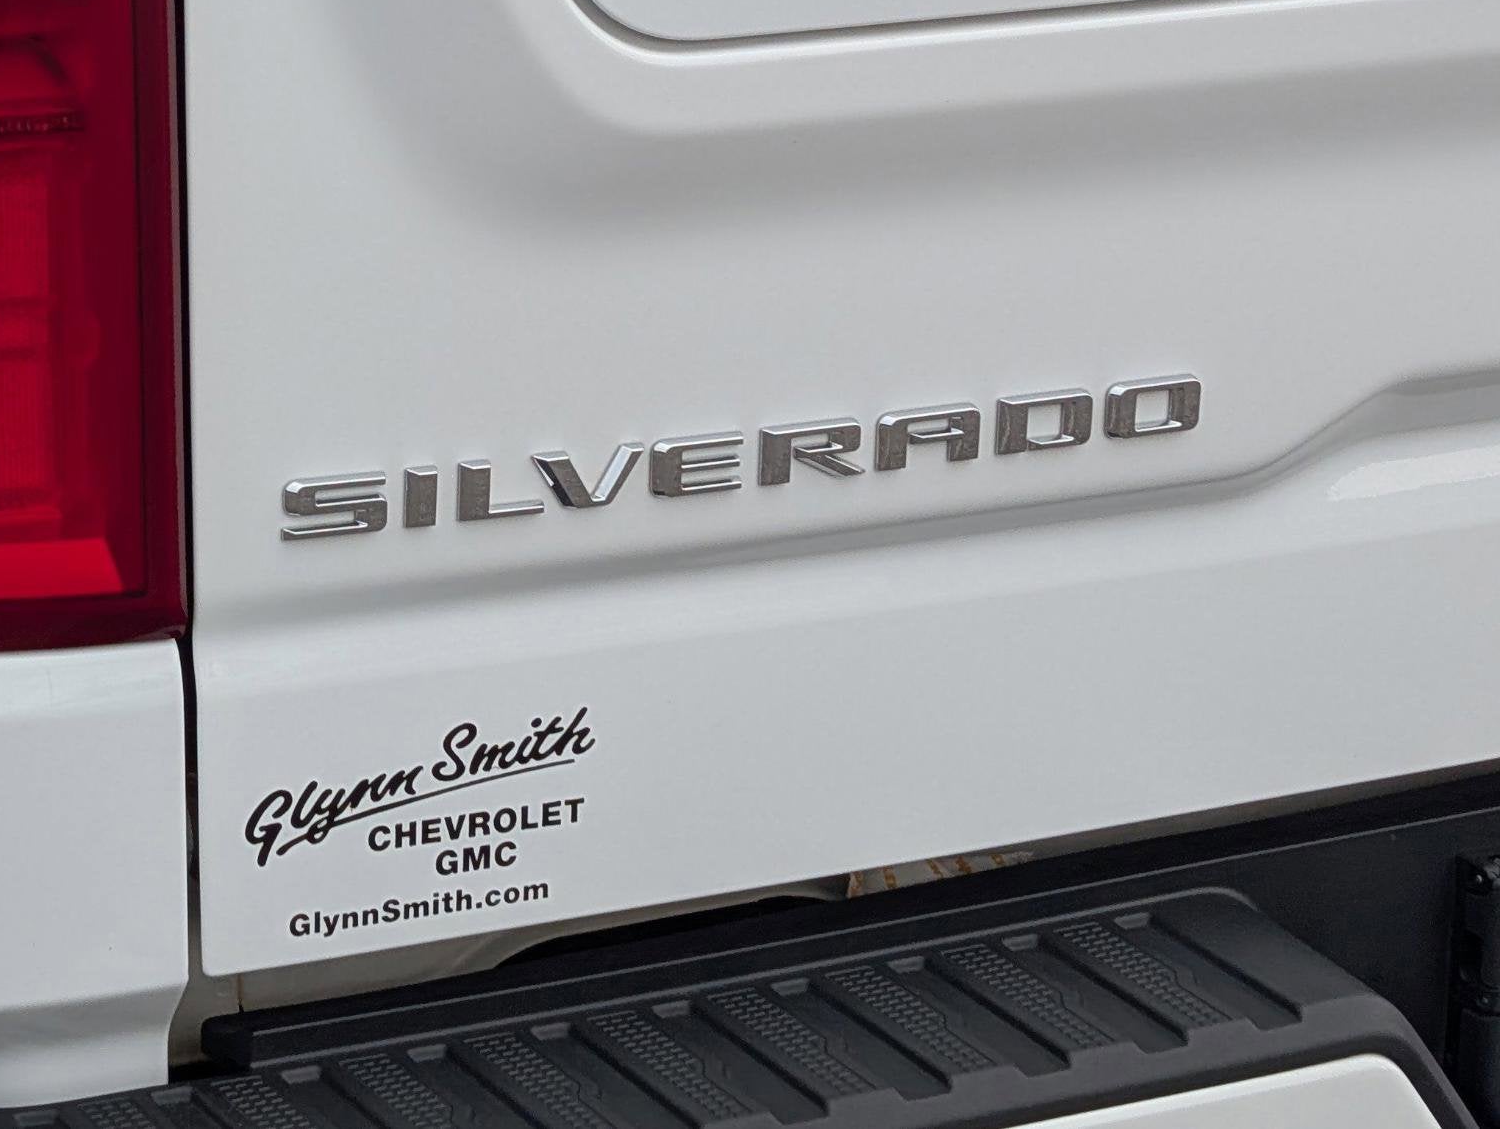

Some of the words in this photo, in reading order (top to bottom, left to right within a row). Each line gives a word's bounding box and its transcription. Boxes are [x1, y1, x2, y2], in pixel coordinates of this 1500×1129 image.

[280, 372, 1203, 542] SILVERADO
[244, 765, 424, 867] Glynn
[431, 706, 596, 782] Smith
[367, 797, 585, 852] CHEVROLET
[435, 841, 517, 876] GMC
[289, 882, 550, 938] GlynnSmith.com
